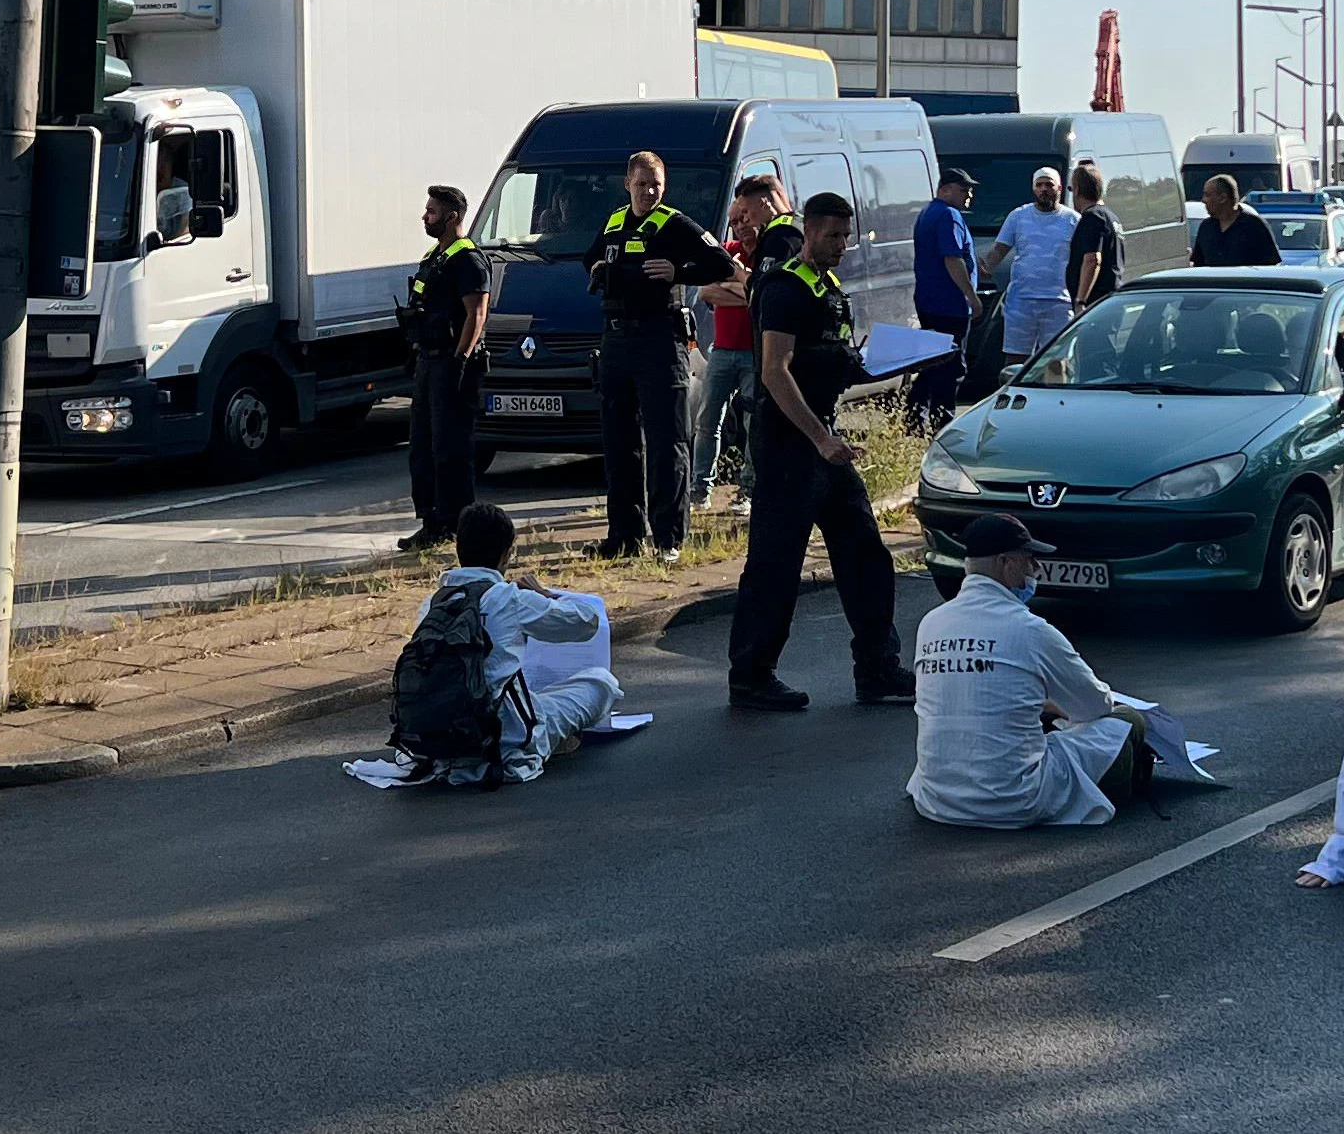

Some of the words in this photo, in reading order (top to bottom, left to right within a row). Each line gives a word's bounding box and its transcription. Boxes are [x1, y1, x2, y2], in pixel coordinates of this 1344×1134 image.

[494, 397, 502, 411] B
[511, 397, 528, 411] SH
[529, 397, 561, 412] 6488
[1058, 563, 1107, 585] 2798
[921, 638, 997, 657] SCIENTIST
